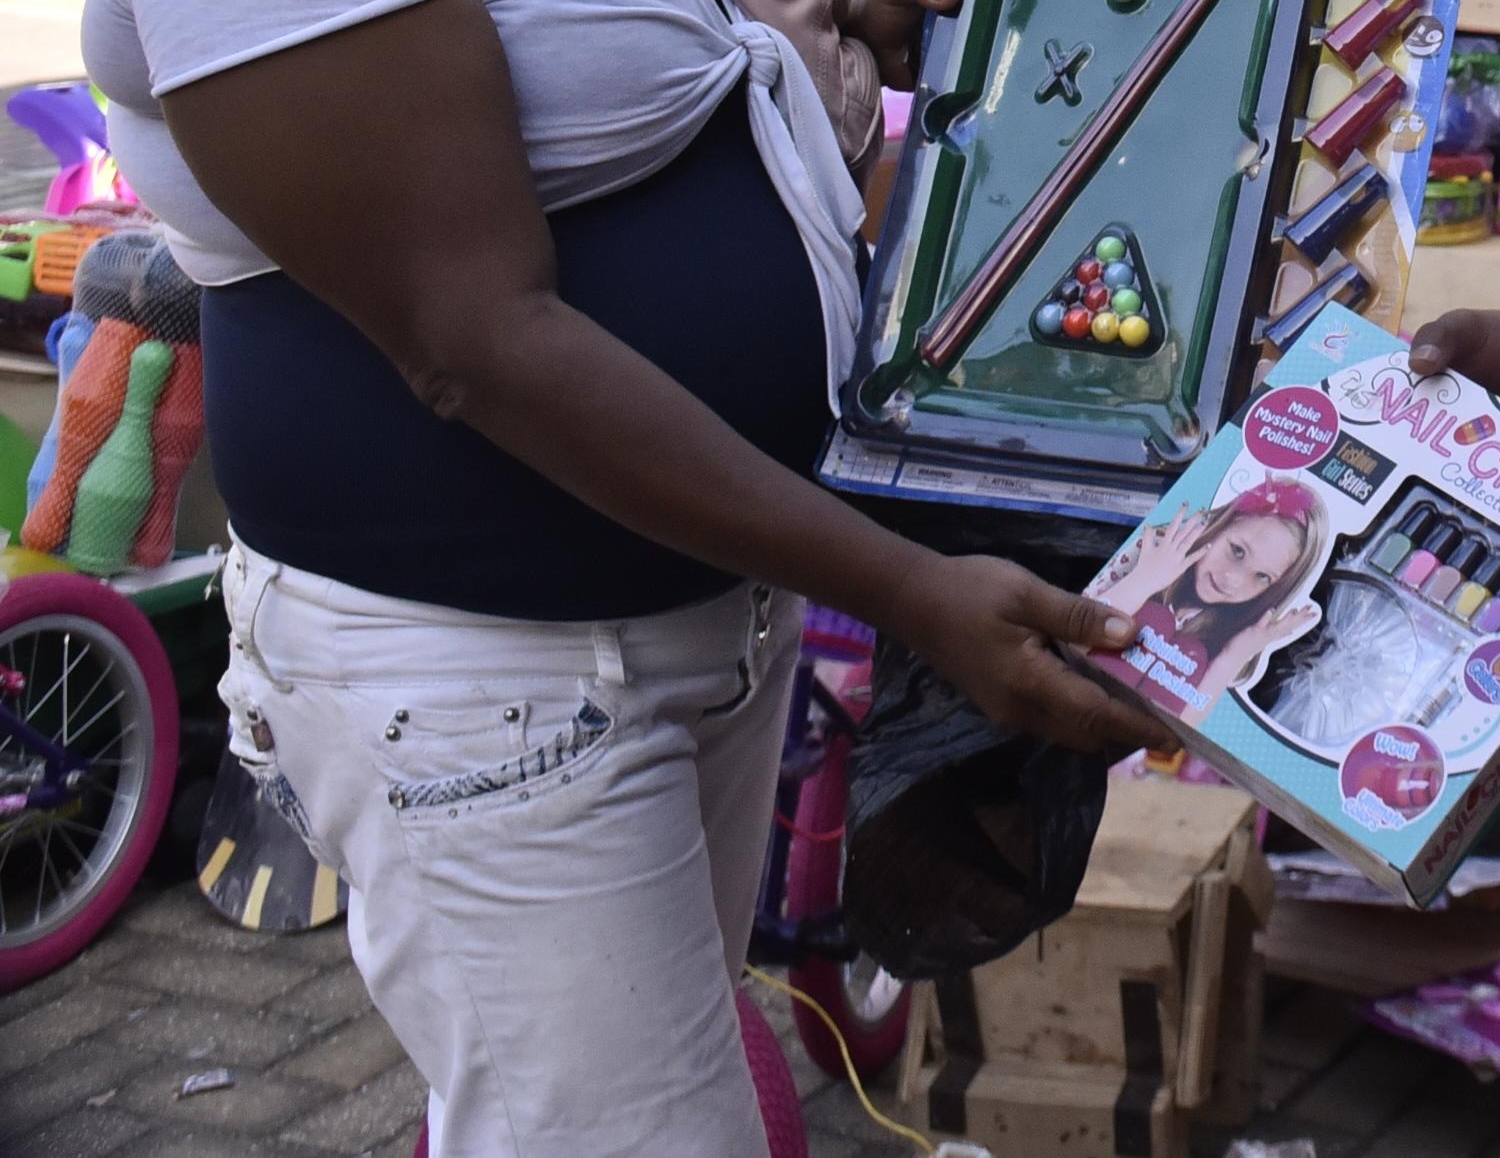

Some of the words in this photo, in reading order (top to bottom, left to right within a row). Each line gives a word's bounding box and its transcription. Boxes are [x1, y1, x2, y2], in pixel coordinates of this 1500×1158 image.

[1254, 406, 1306, 434] Mystery
[1306, 425, 1334, 444] Nail
[1287, 401, 1322, 423] Make
[1376, 376, 1458, 459] NAIL
[1258, 425, 1316, 456] Polishes!
[1335, 440, 1378, 476] Fashion
[1321, 458, 1346, 483] Girl
[1338, 468, 1373, 501] Series
[1147, 659, 1213, 712] Designs!
[1374, 732, 1420, 762] Wow!
[1423, 813, 1478, 876] NAIL
